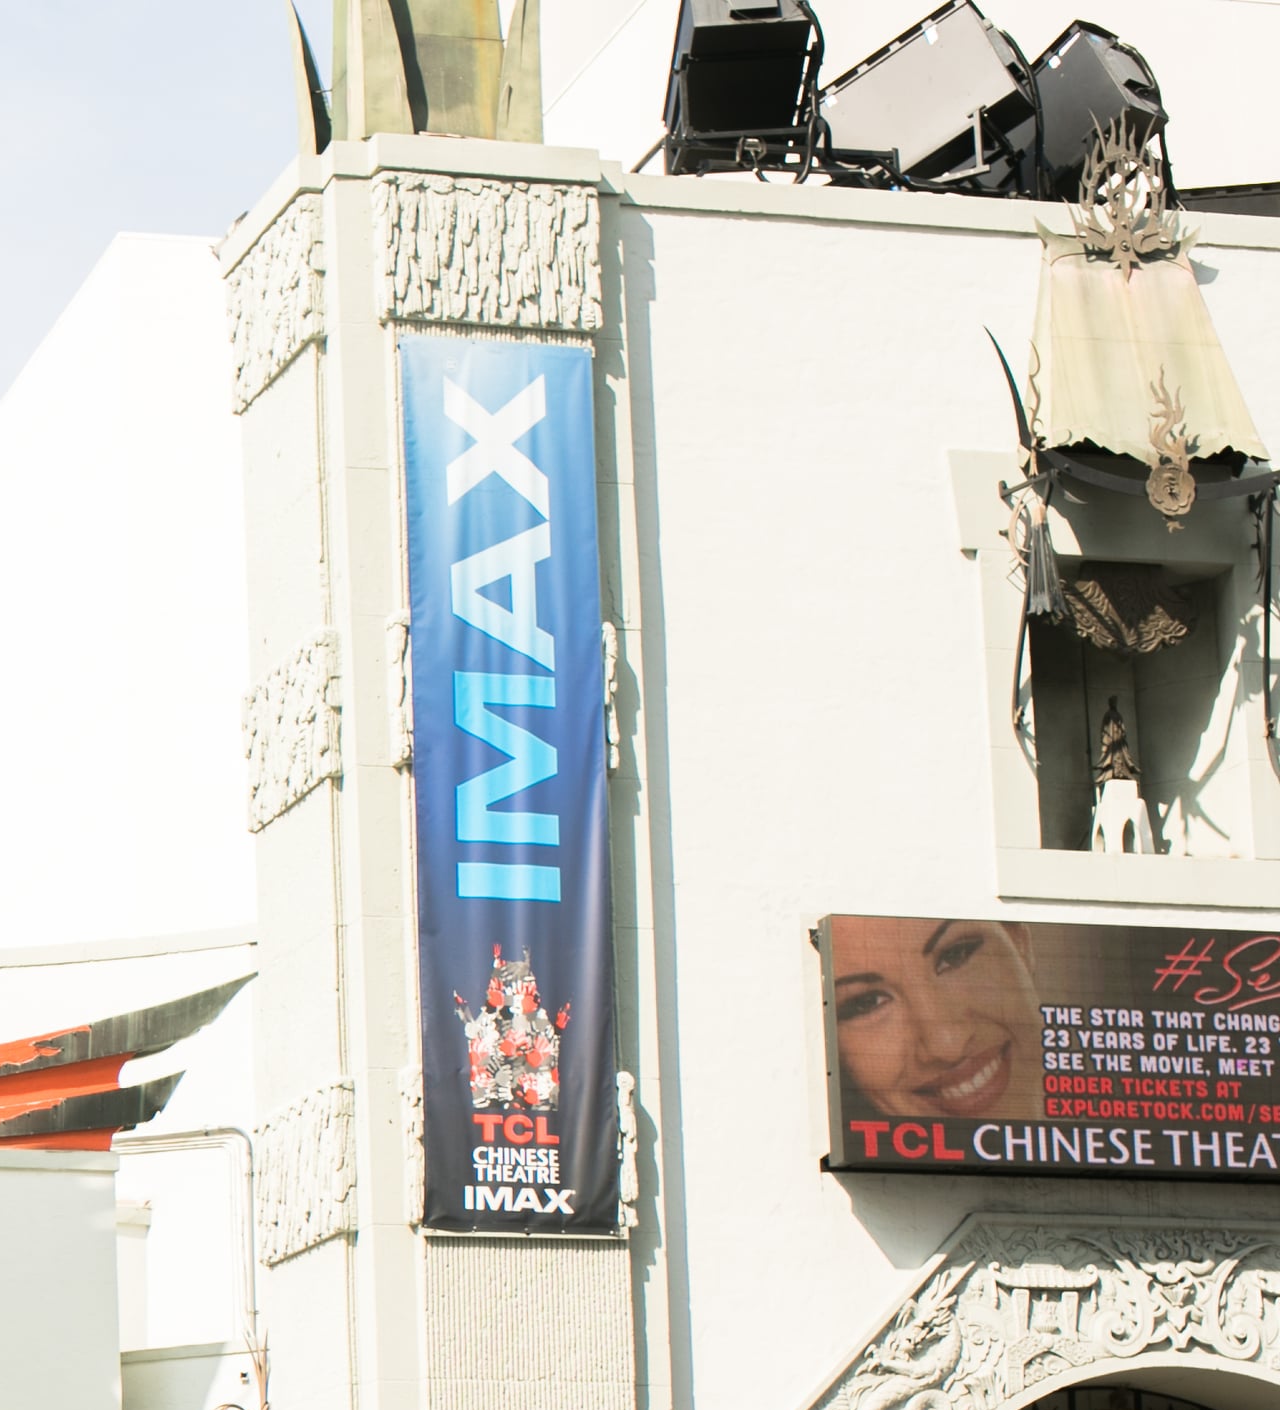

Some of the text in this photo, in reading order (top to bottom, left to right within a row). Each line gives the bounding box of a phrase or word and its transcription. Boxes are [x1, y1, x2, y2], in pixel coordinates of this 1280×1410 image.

[443, 372, 563, 903] IMAX
[1041, 1007, 1083, 1025] THE
[1090, 1008, 1144, 1027] STAR
[1151, 1011, 1205, 1029] THAT
[1043, 1029, 1070, 1048] 23
[1078, 1030, 1145, 1050] YEARS
[1153, 1033, 1178, 1051] OF
[1187, 1035, 1238, 1053] LIFE.
[1245, 1036, 1271, 1055] 23
[1044, 1052, 1275, 1077] SEE THE MOVIE, MEET
[1045, 1075, 1242, 1099] ORDER TICKETS AT
[472, 1113, 560, 1145] TCL
[850, 1121, 965, 1160] TCL
[973, 1123, 1155, 1165] CHINESE
[472, 1146, 559, 1167] CHINESE
[473, 1164, 560, 1185] THEATRE
[464, 1185, 576, 1215] IMAX
